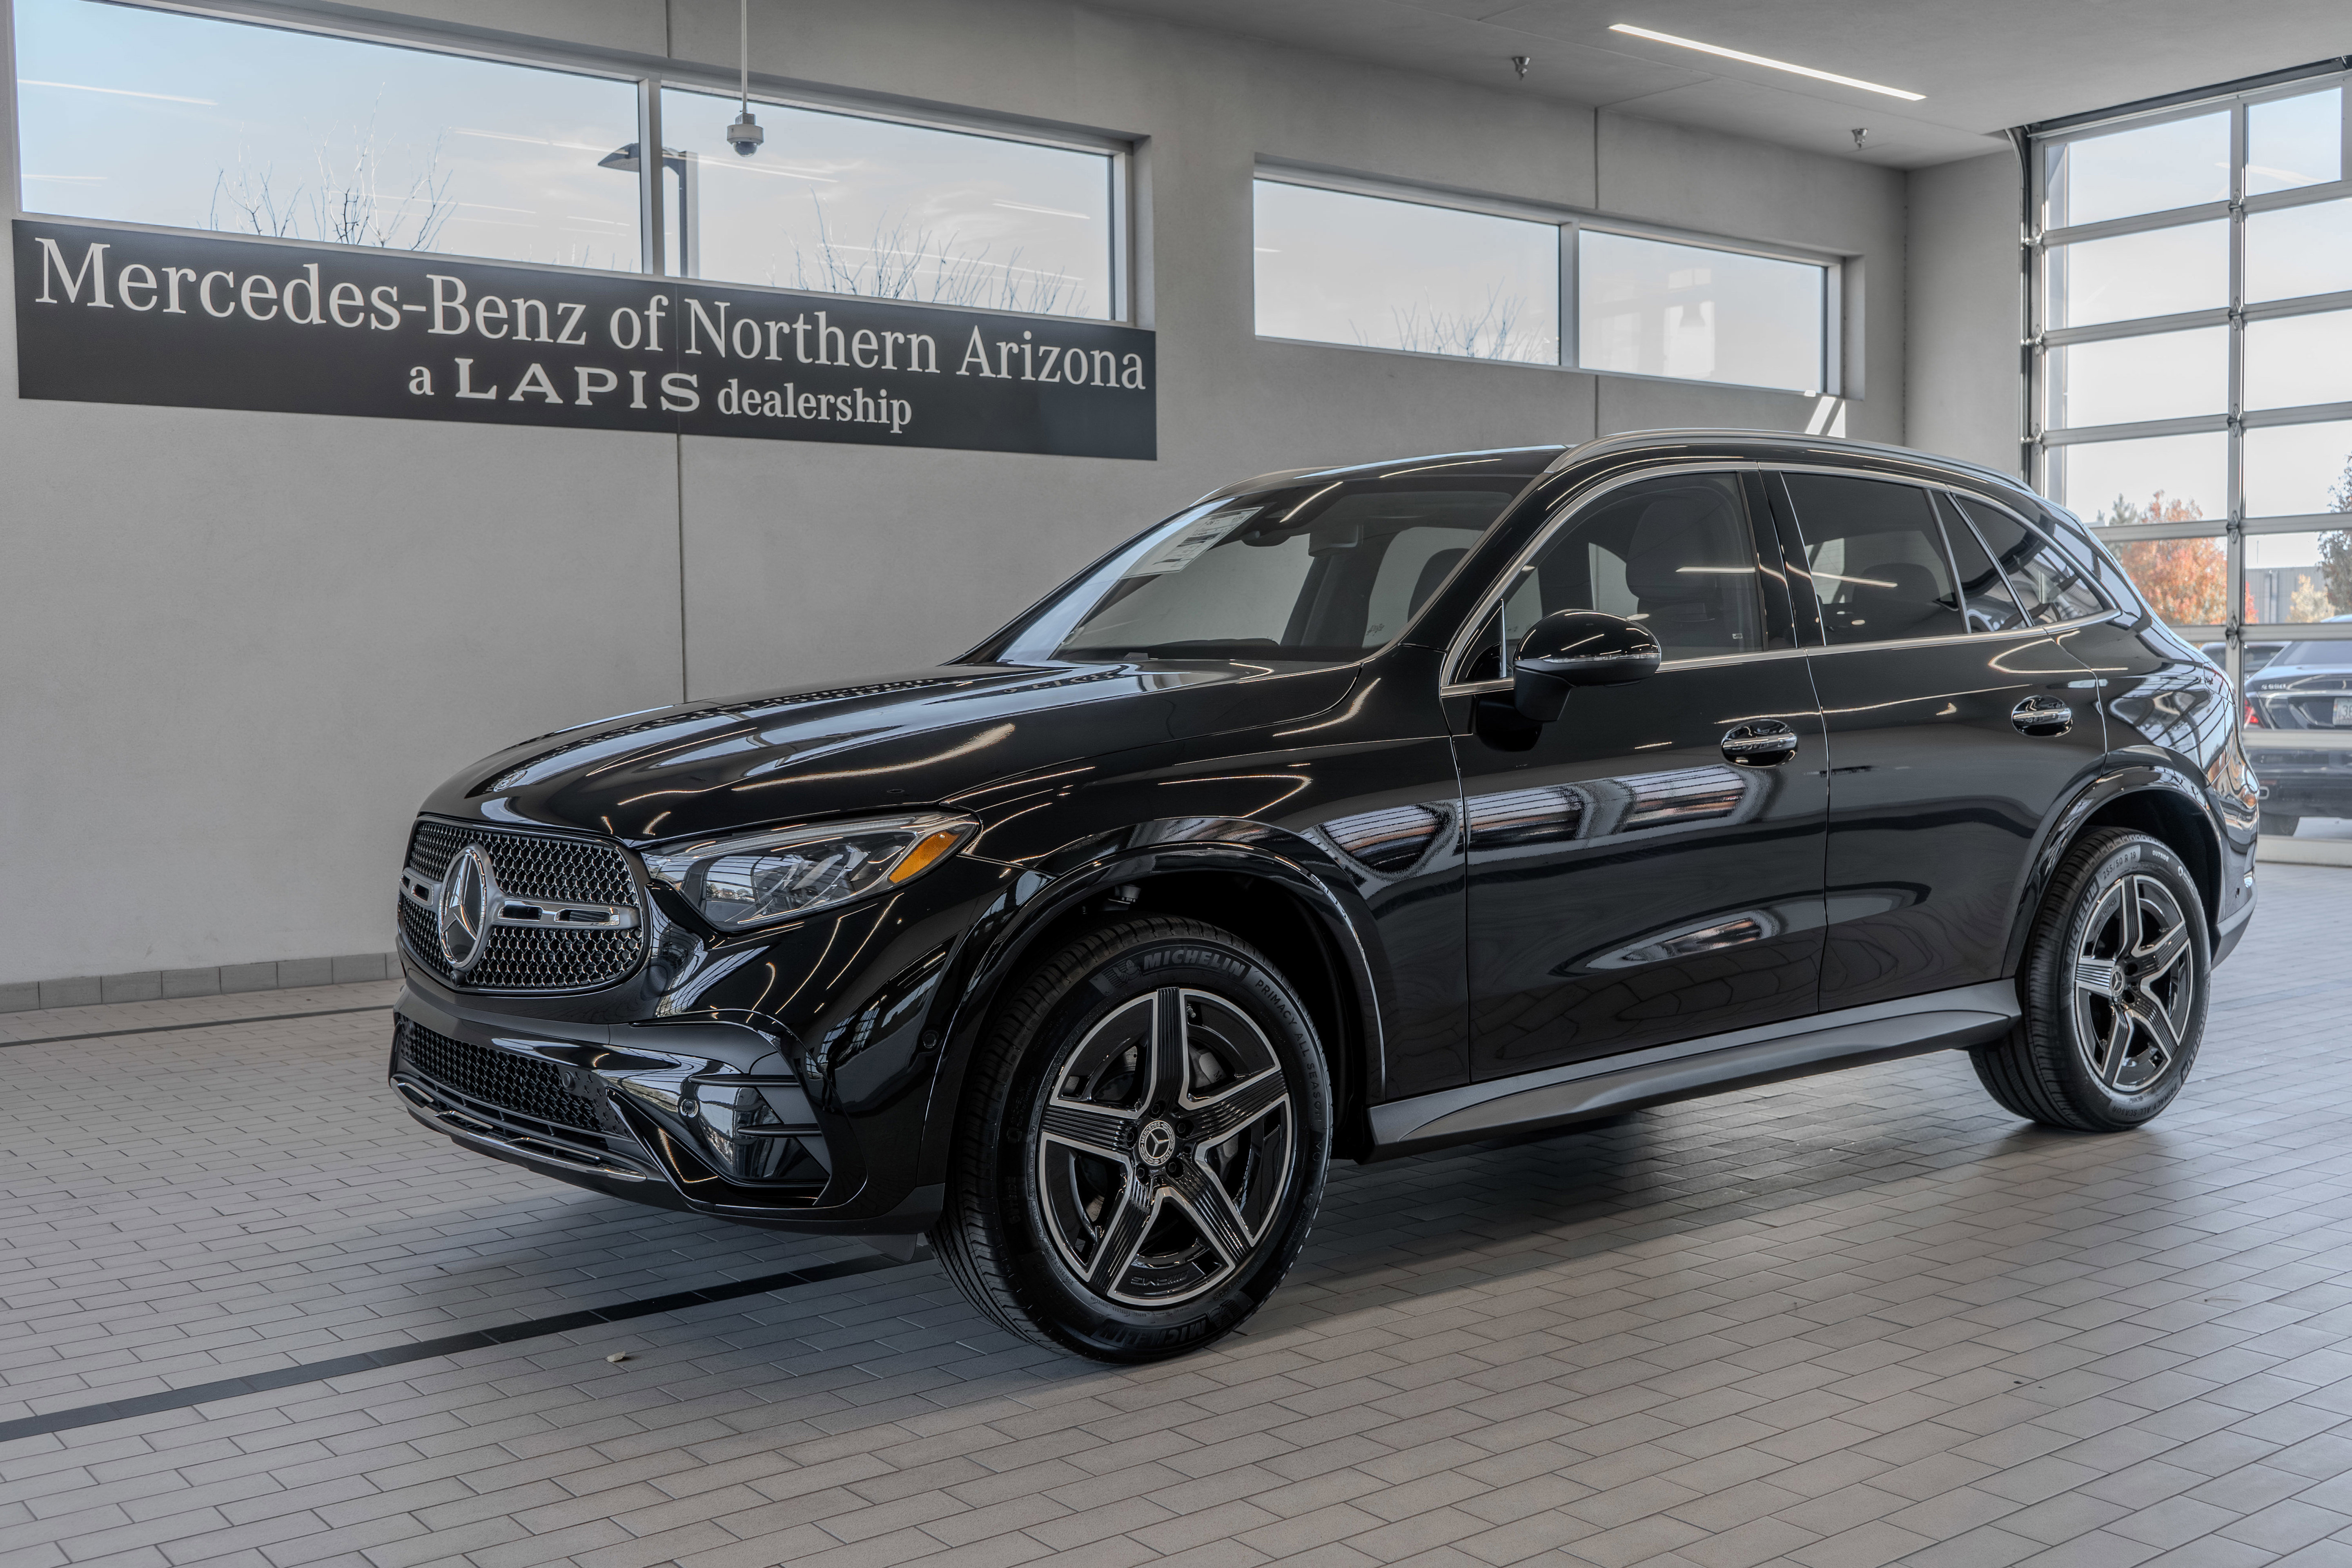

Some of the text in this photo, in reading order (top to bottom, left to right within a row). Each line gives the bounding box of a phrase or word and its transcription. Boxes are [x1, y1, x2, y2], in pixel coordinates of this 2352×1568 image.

[35, 237, 1146, 390] Mercedes-Benz of Northern Arizona
[409, 357, 912, 434] a LAPIS dealership
[2103, 851, 2136, 880] 255/50 R 19
[2152, 850, 2169, 863] OUTSIDE
[2067, 883, 2098, 964] MICHELIN
[1144, 949, 1246, 977] MICHELIN
[1255, 979, 1322, 1123] PRIMACY ALL SEASON
[1140, 1122, 1161, 1143] MERCEDES
[1160, 1149, 1172, 1163] BENZ
